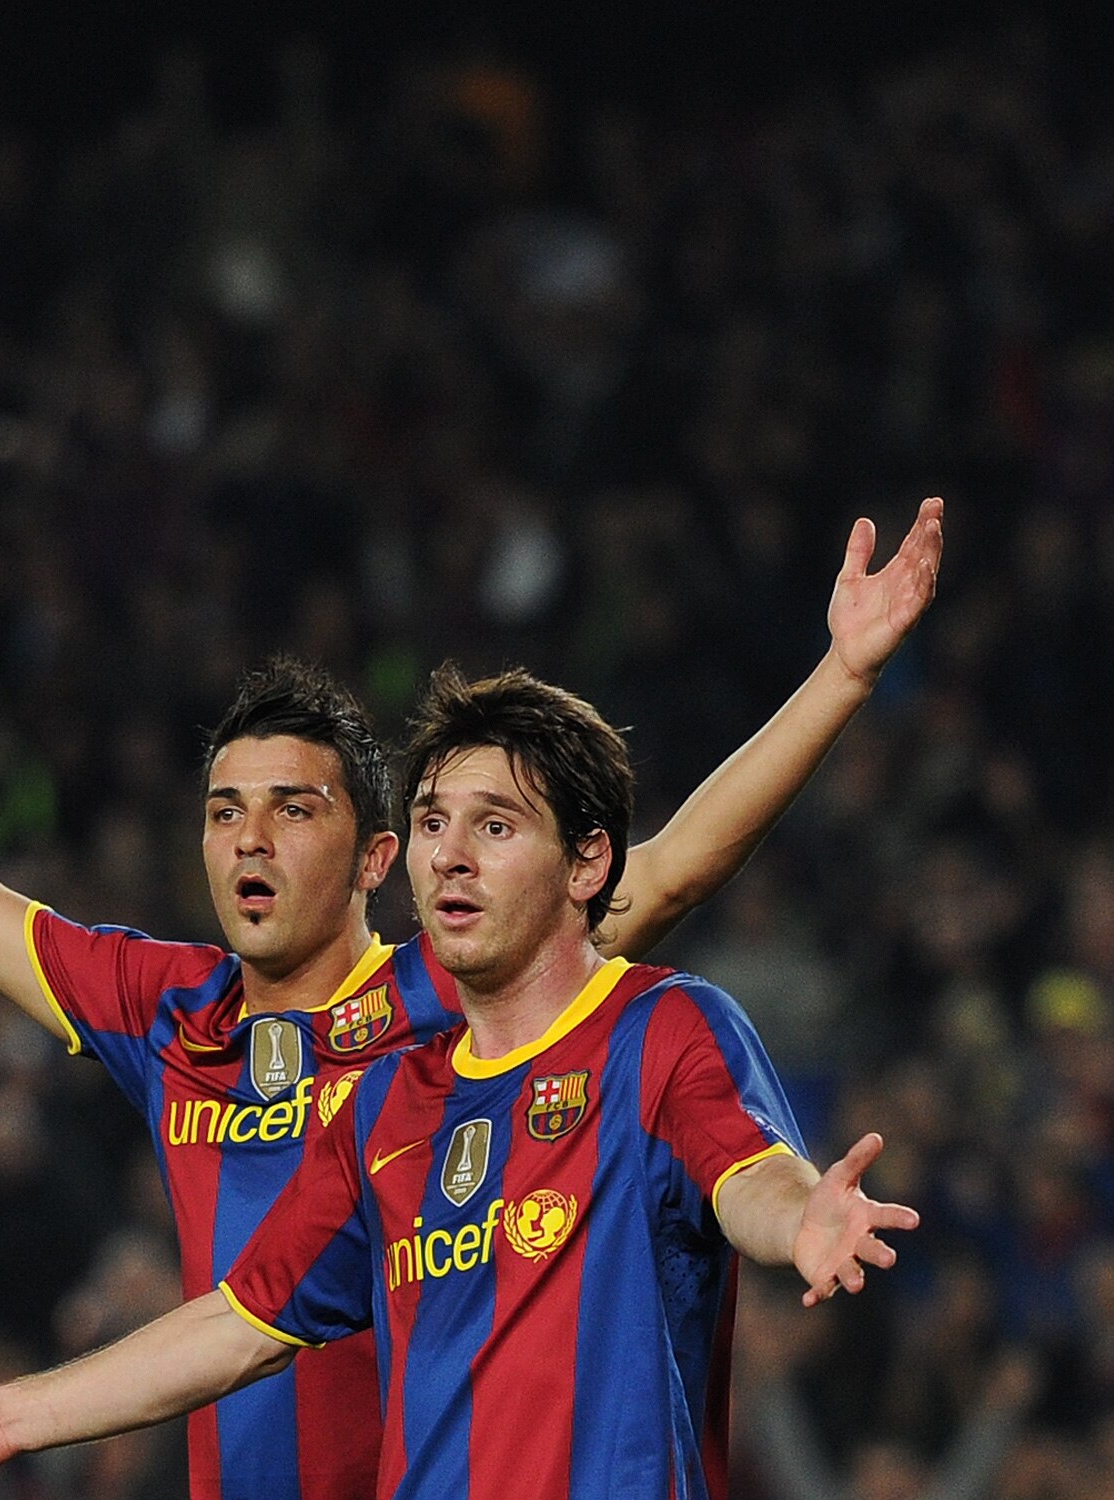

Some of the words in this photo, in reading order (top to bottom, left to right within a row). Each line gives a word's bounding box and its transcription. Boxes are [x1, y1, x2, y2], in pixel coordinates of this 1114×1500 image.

[265, 1071, 287, 1082] FIFA
[168, 1076, 315, 1146] unicef
[452, 1172, 472, 1184] FIFA
